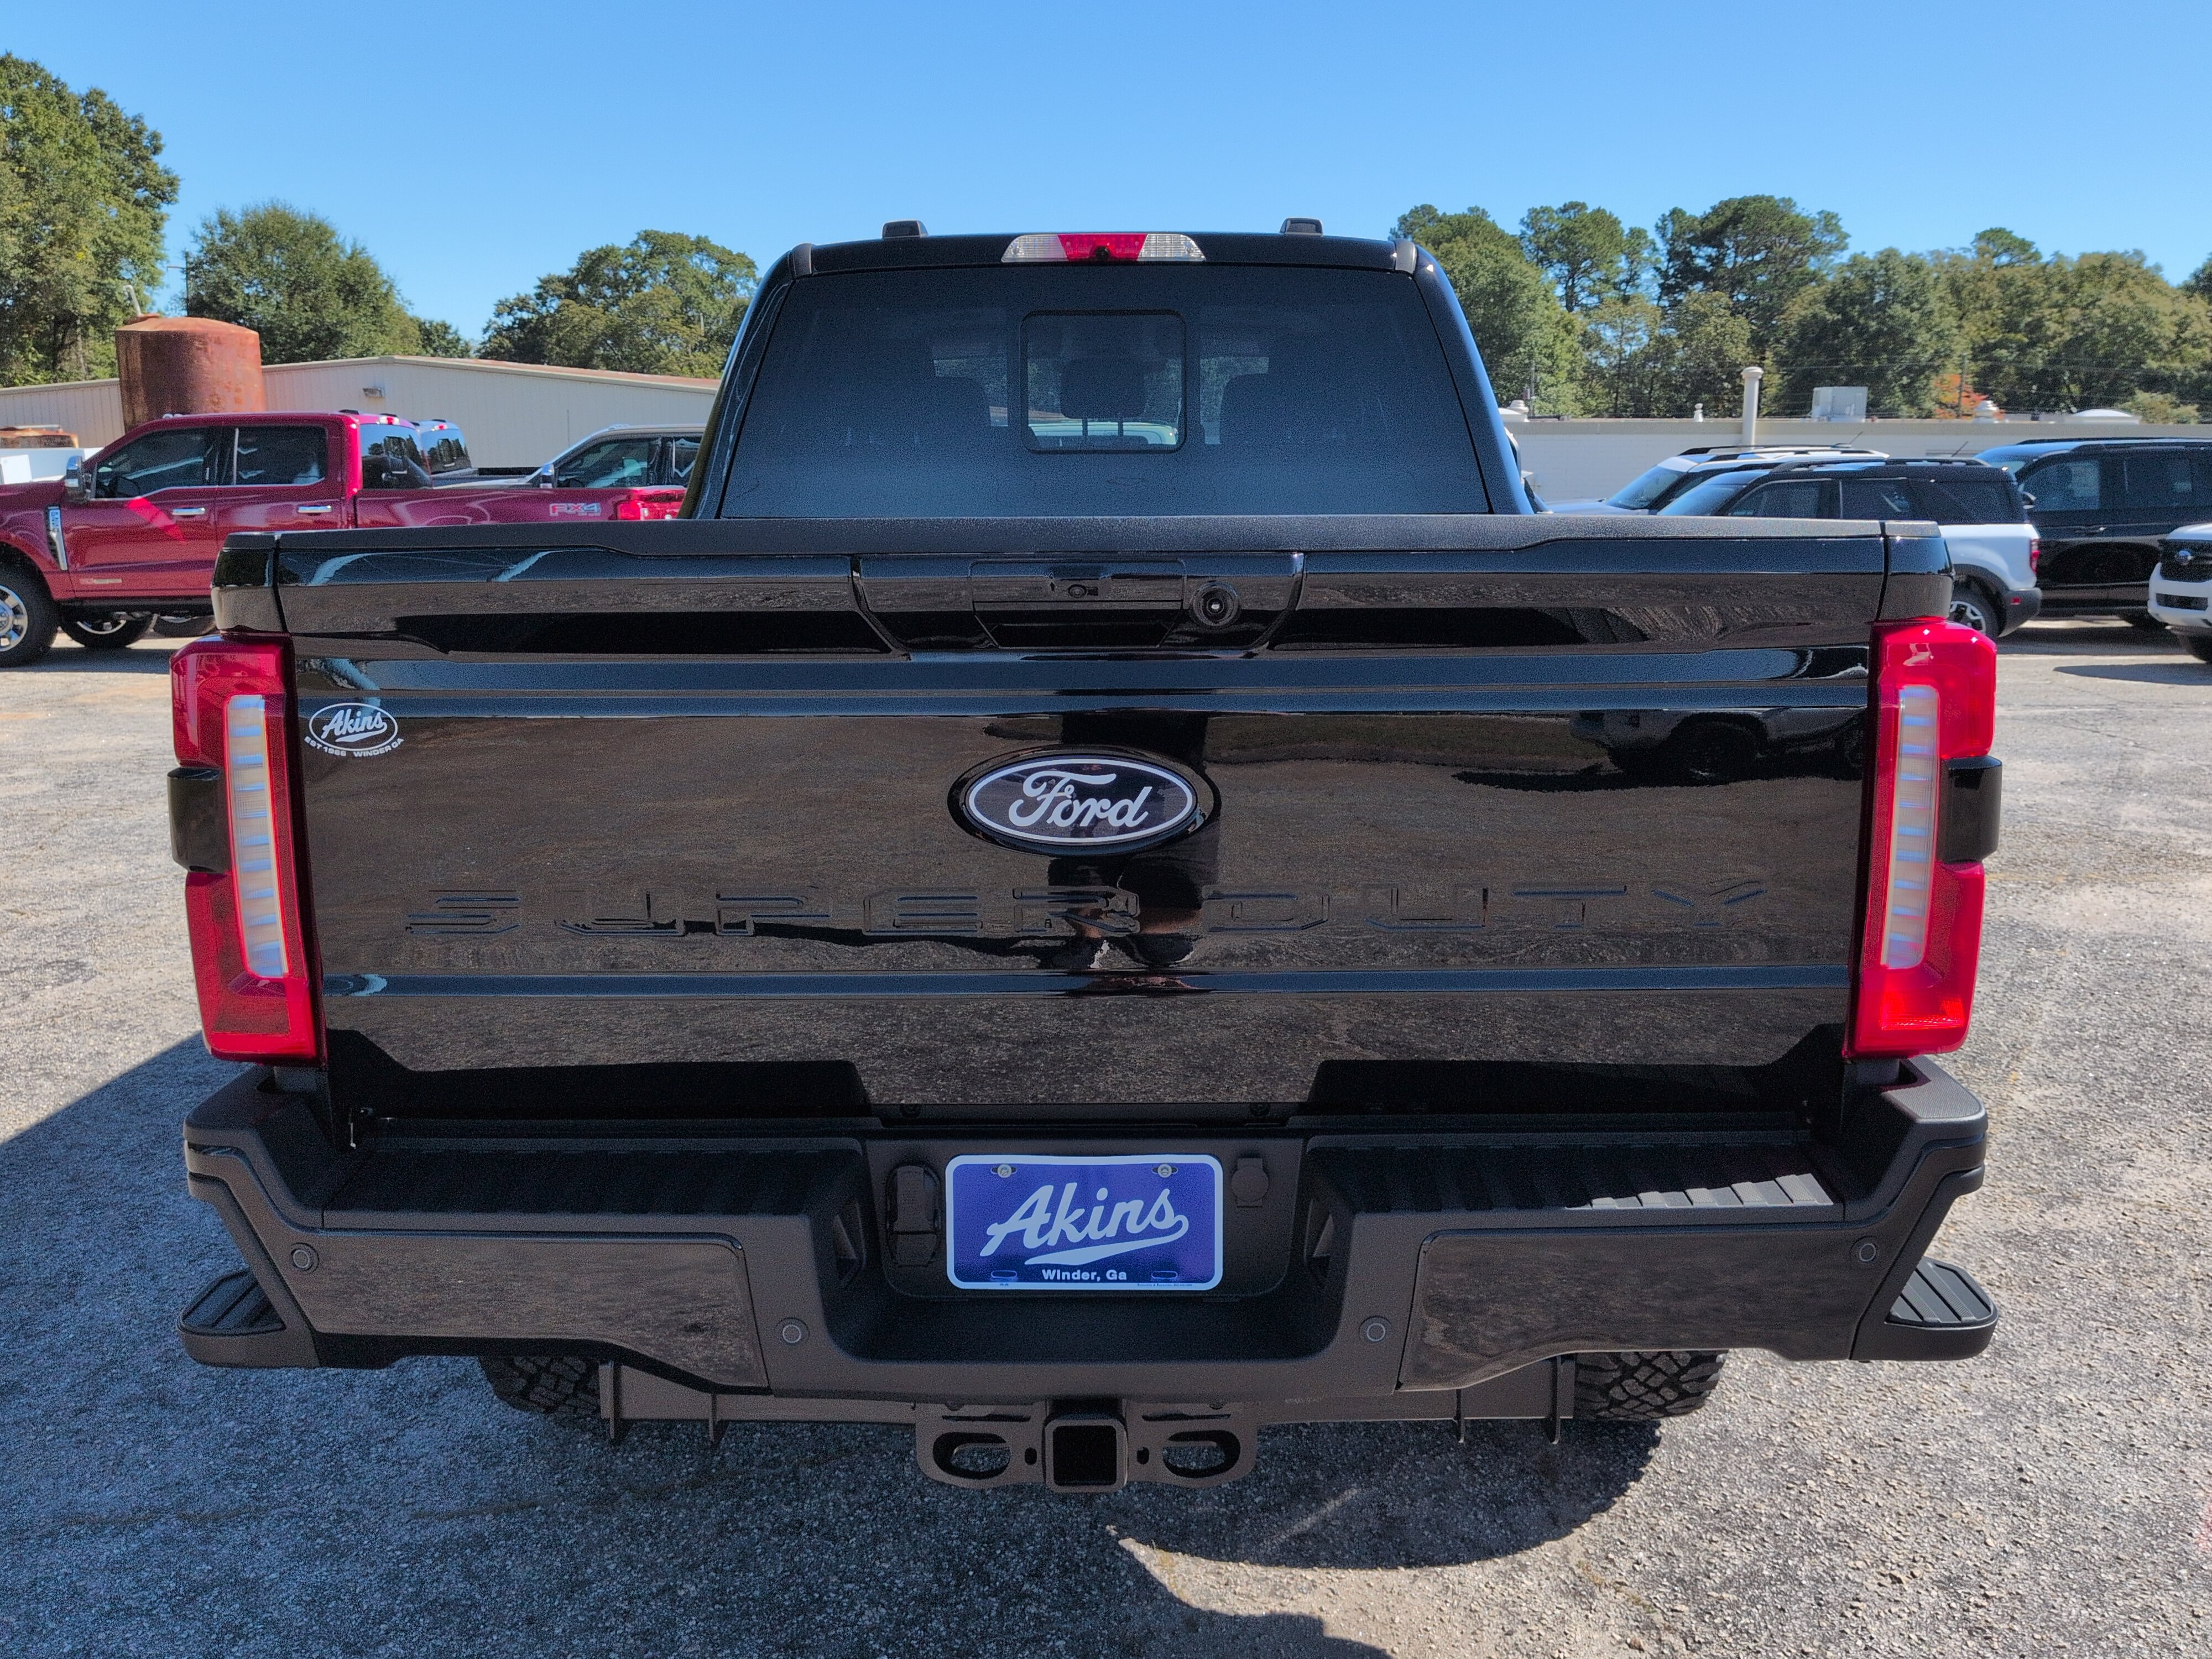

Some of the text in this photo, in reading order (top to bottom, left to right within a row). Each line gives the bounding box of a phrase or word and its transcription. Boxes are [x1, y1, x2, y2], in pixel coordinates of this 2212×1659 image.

[549, 503, 601, 517] FX4
[321, 709, 387, 739] Akins
[353, 745, 392, 757] WINDER
[391, 738, 404, 748] GA
[1009, 771, 1153, 827] Ford
[979, 1182, 1189, 1256] Akins
[1041, 1269, 1128, 1282] Winder, Ga
